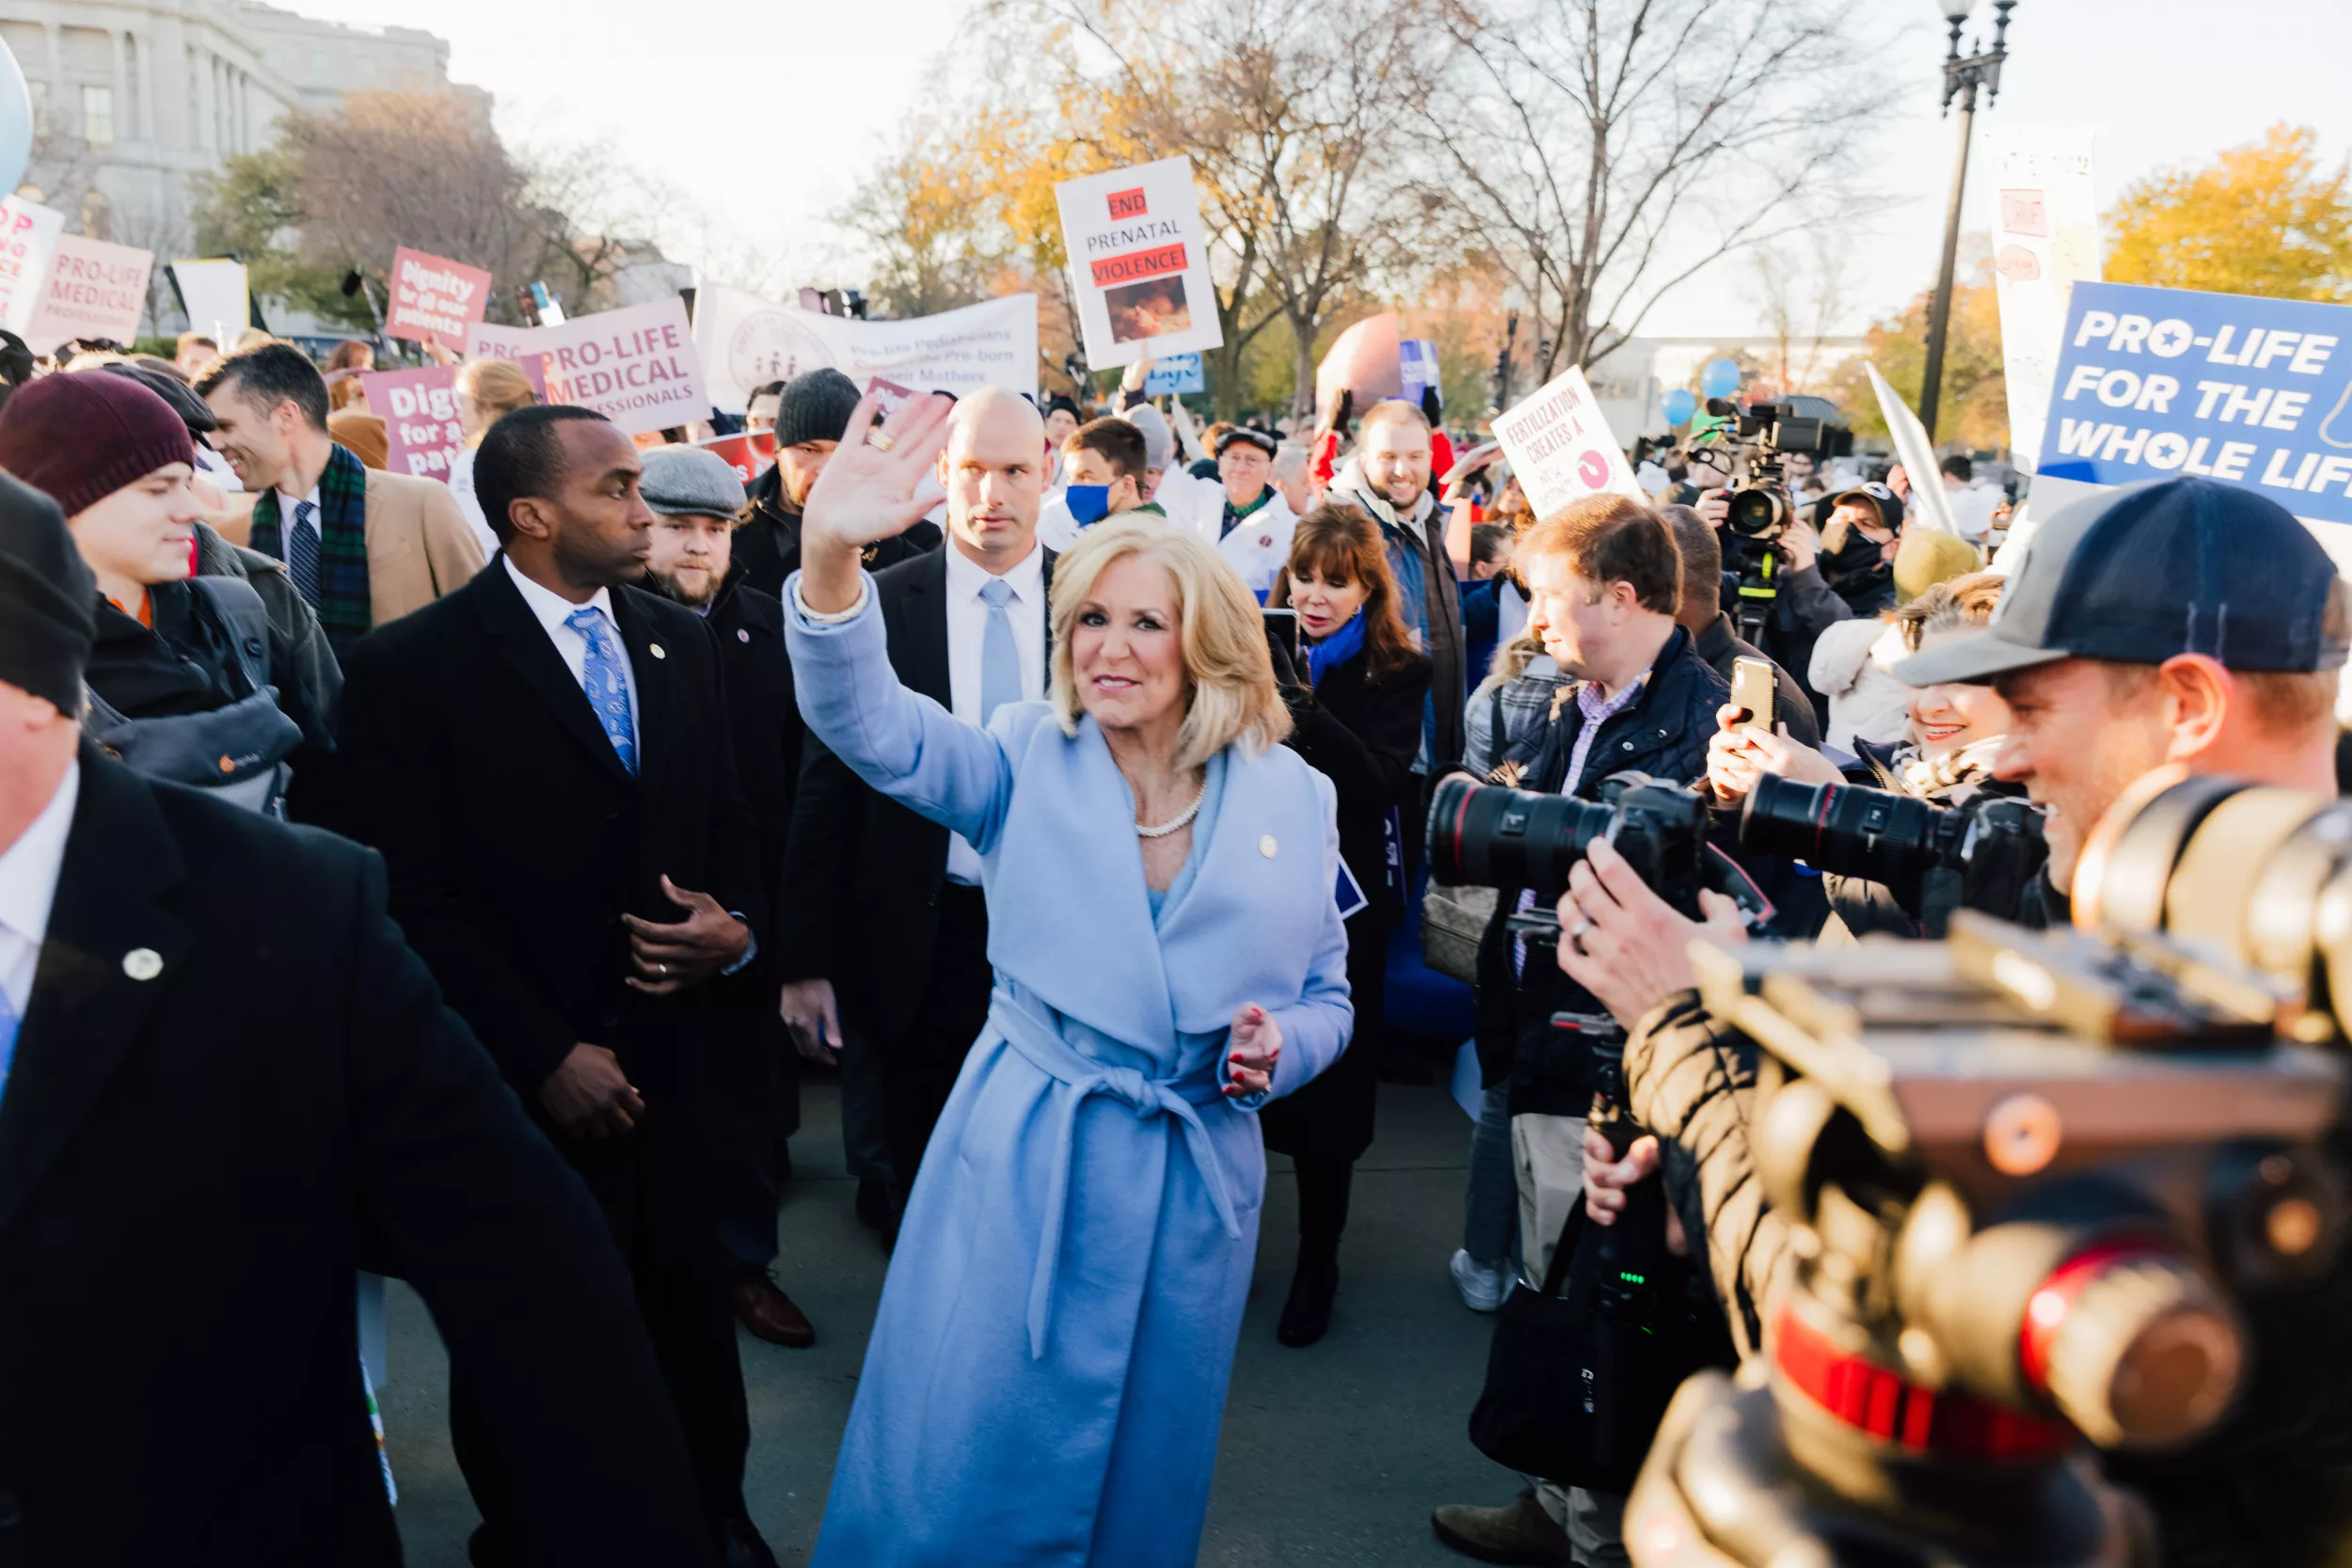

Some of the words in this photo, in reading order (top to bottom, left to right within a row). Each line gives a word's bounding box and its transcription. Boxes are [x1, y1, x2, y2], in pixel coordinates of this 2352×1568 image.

[1108, 194, 1147, 217] END
[1087, 219, 1182, 253] PRENATAL
[56, 253, 143, 289] PRO-LIFE
[401, 259, 476, 304] Dignity
[1091, 249, 1187, 282] VIOLENCE!
[50, 278, 135, 312] MEDICAL
[394, 307, 465, 338] patients
[2074, 309, 2339, 375] PRO-LIFE
[541, 324, 681, 376] PRO-LIFE
[547, 356, 689, 405] MEDICAL
[919, 368, 986, 384] Mothers
[1506, 385, 1581, 448] FERTILIZATION
[2062, 364, 2181, 414] FOR
[2194, 379, 2312, 432] THE
[399, 423, 439, 446] for
[1525, 422, 1573, 465] CREATES
[1571, 416, 1584, 437] A
[2058, 418, 2258, 482] WHOLE
[2259, 448, 2352, 499] LIF
